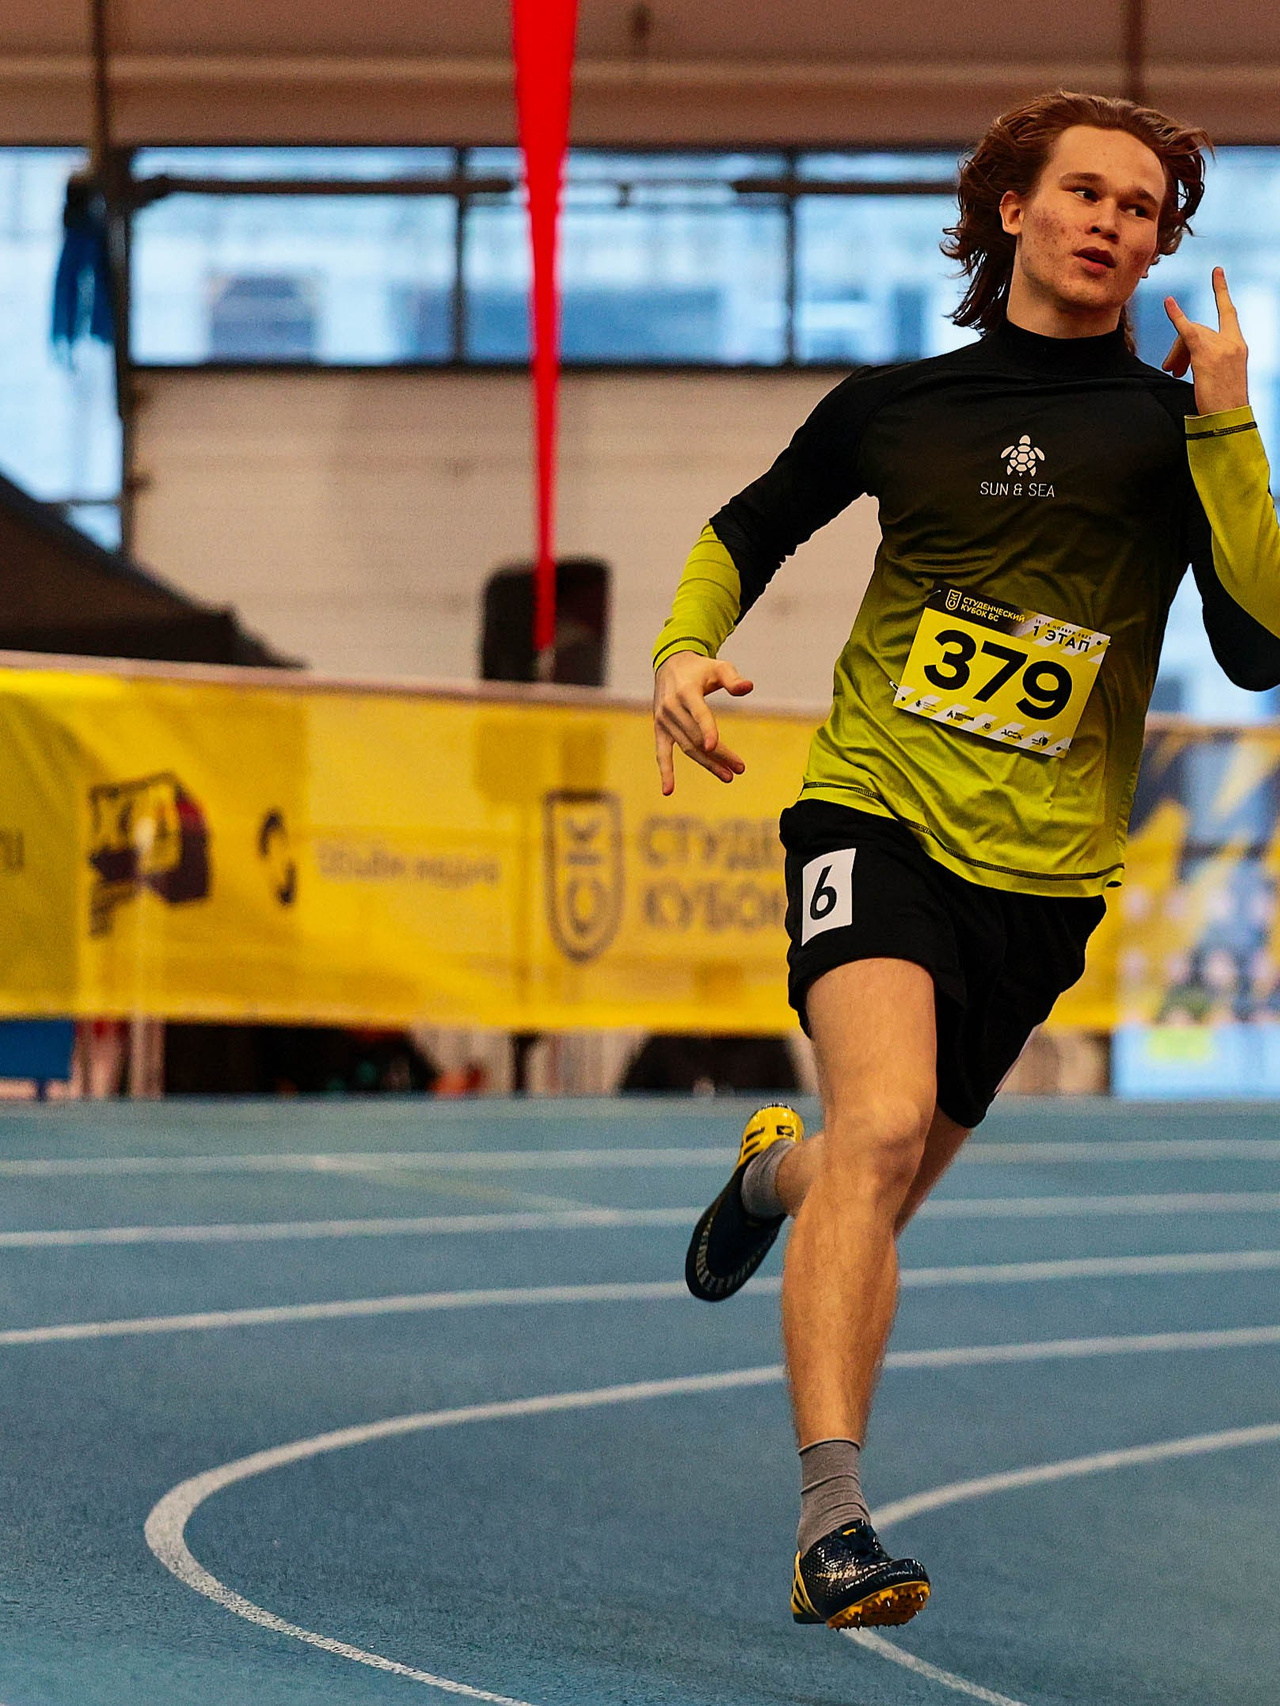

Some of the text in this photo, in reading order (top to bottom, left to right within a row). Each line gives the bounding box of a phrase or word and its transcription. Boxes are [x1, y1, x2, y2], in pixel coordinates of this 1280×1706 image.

[980, 481, 1055, 498] SUN & SEA
[960, 604, 1000, 622] КУБОК БС
[963, 596, 1026, 623] СТУДЕНЧЕСКИЙ
[1033, 625, 1090, 652] 1 ЭТАП
[924, 629, 1073, 721] 379
[810, 864, 837, 921] 6
